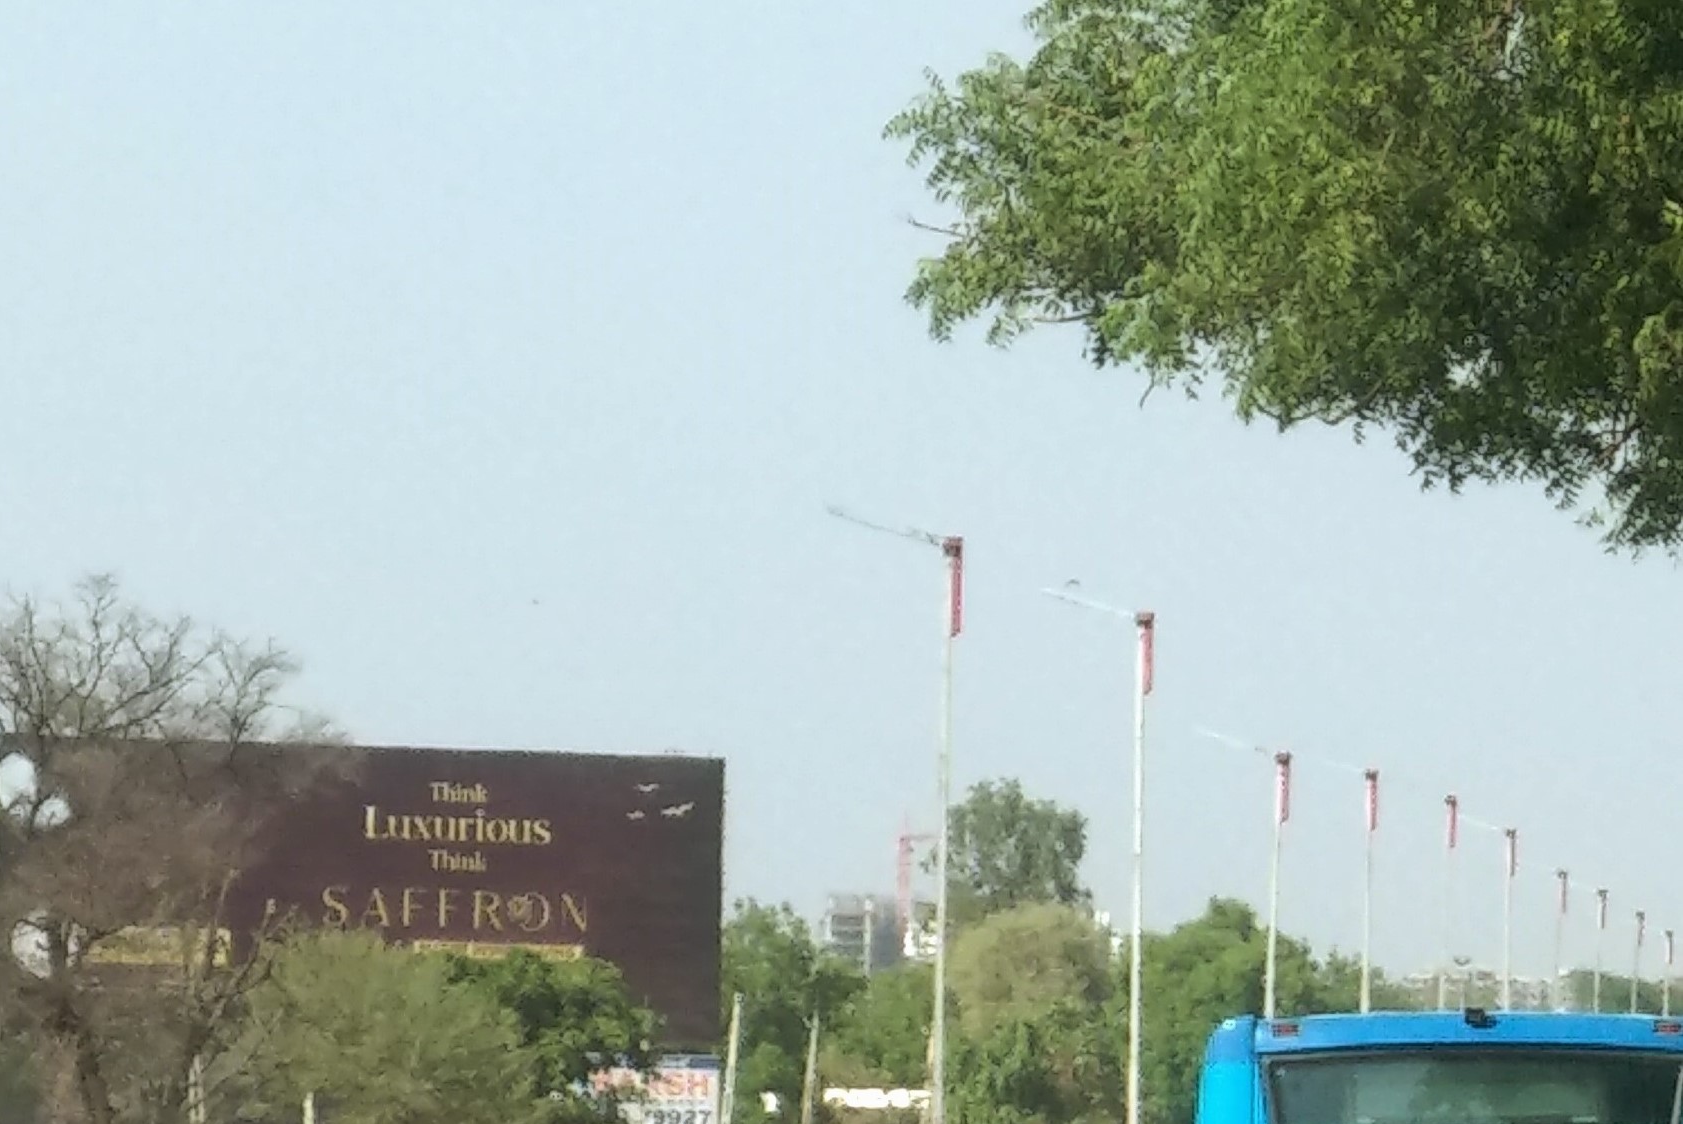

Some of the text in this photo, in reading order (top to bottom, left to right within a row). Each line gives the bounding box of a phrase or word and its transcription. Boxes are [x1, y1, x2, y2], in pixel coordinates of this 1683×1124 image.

[429, 780, 488, 802] Think
[364, 803, 552, 844] Luxurious
[428, 849, 487, 871] Think
[322, 886, 587, 932] SAFFRON
